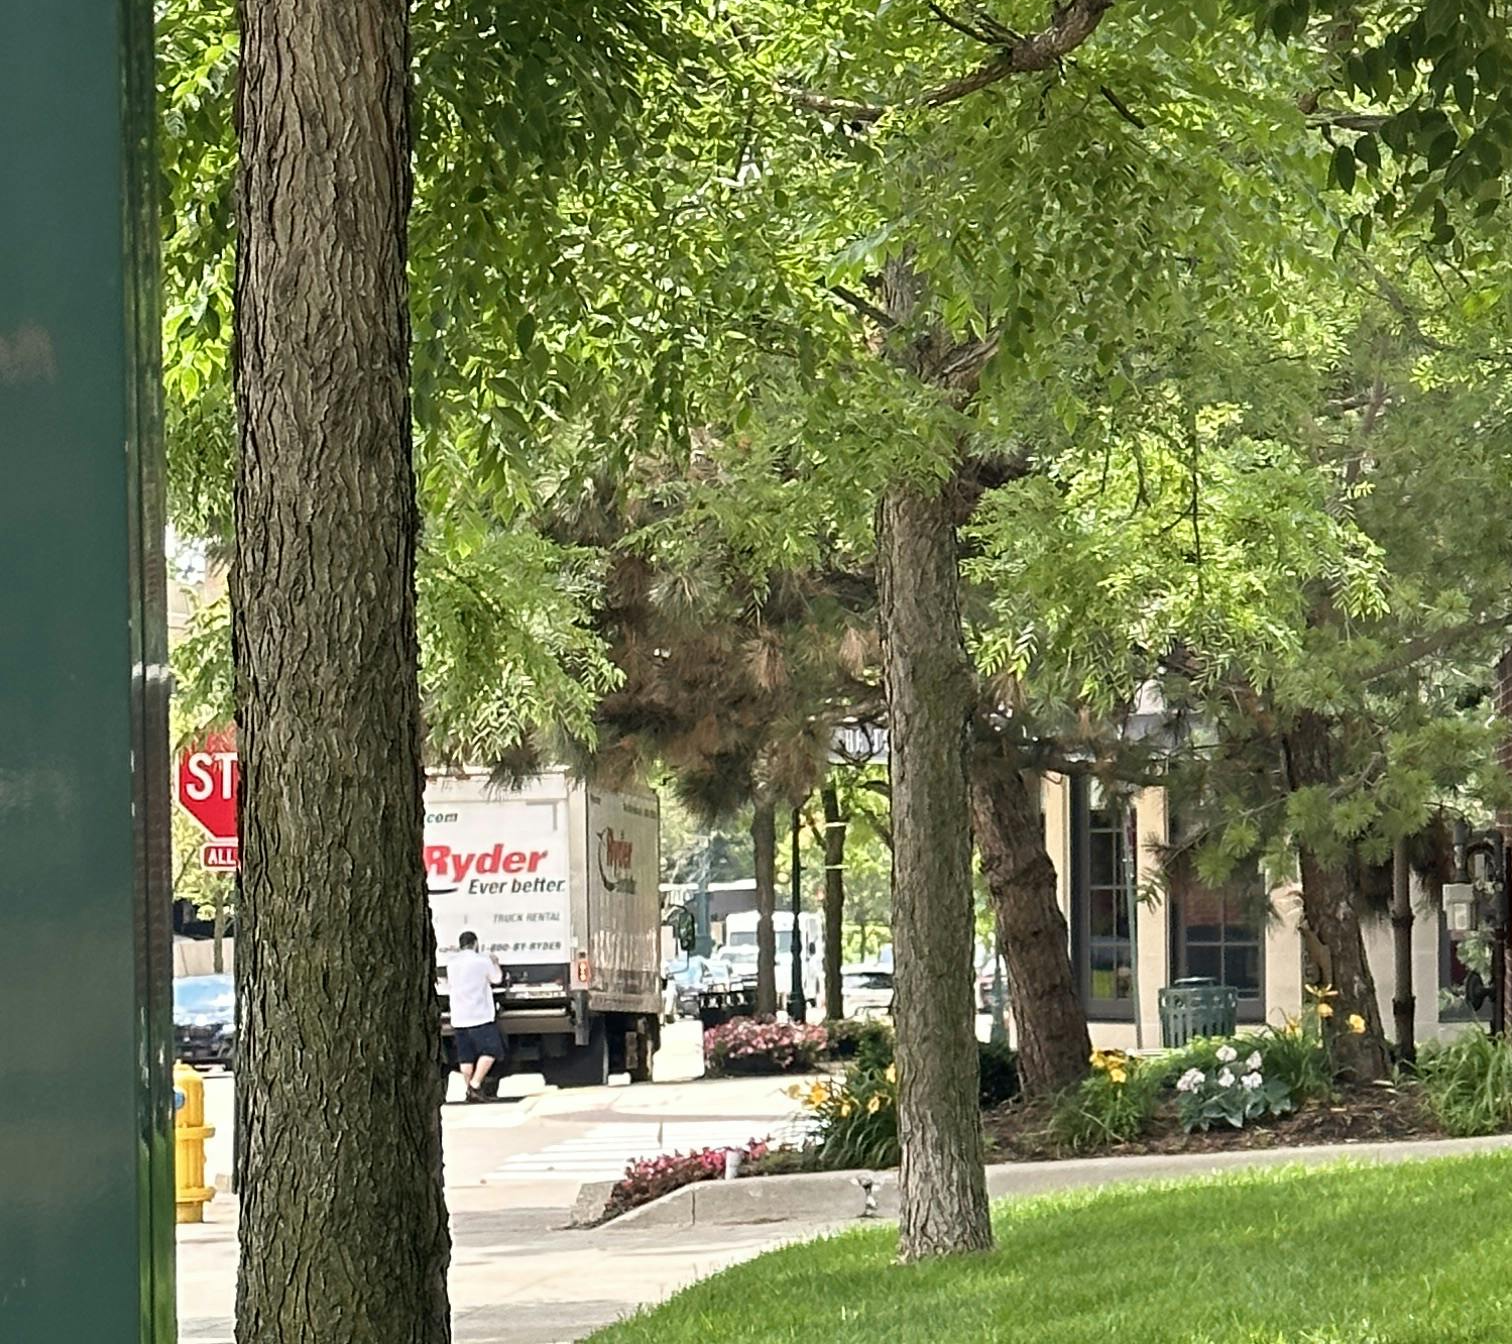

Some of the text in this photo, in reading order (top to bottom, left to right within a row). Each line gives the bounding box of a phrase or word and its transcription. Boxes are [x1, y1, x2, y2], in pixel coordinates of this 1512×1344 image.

[185, 751, 239, 802] ST
[207, 847, 237, 865] ALL
[424, 842, 549, 883] Ryder
[468, 878, 508, 895] Ever
